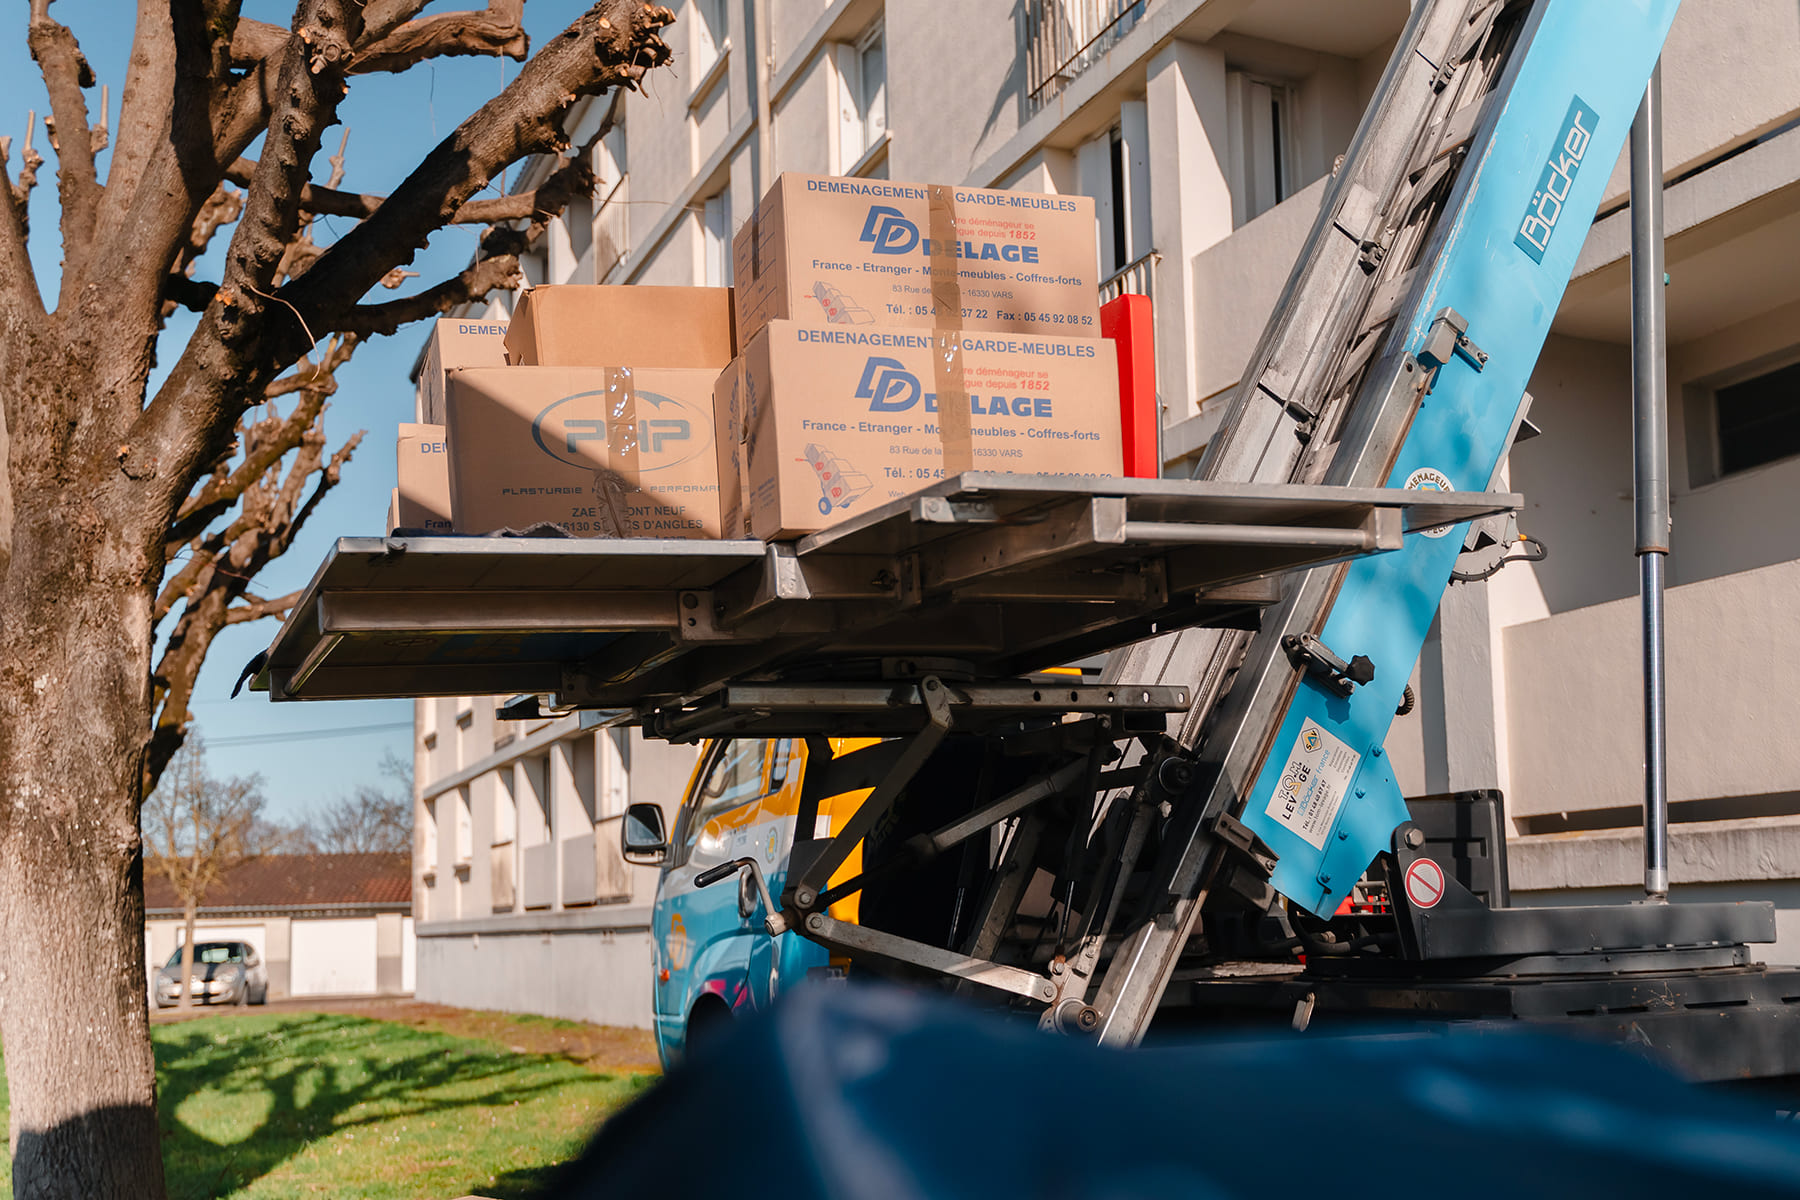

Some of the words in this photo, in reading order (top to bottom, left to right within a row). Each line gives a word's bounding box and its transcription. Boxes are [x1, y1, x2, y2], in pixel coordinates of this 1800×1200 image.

[1519, 110, 1591, 252] Böcker
[807, 180, 935, 200] DEMENAGEMENT
[955, 192, 1077, 212] GARDE-MEUBLES
[968, 217, 1022, 230] déménageur
[978, 229, 1006, 239] depuis
[1009, 230, 1036, 241] 1852
[812, 259, 853, 271] France
[863, 262, 912, 276] Etranger
[1016, 272, 1082, 286] Coffres-forts
[904, 285, 920, 294] Rue
[967, 290, 990, 298] 16330
[992, 290, 1013, 299] VARS
[886, 303, 905, 314] Tél.
[915, 305, 928, 316] 05
[976, 308, 988, 319] 22
[997, 310, 1014, 321] Fax
[1024, 311, 1036, 322] 05
[1038, 312, 1050, 323] 45
[1053, 314, 1065, 324] 92
[1067, 314, 1079, 325] 08
[1081, 315, 1093, 326] 52
[459, 324, 507, 335] DEMEN
[798, 329, 939, 349] DEMENAGEMENT
[962, 338, 1095, 358] GARDE-MEUBLES
[976, 367, 1034, 380] déménageur
[986, 379, 1017, 390] depuis
[1020, 380, 1050, 391] 1852
[924, 393, 1053, 418] DLAGE
[803, 420, 847, 432] France
[859, 422, 913, 435] Etranger
[1027, 428, 1100, 440] Coffres-forts
[902, 446, 920, 455] Rue
[922, 447, 932, 455] de
[934, 447, 942, 455] la
[972, 448, 997, 457] 16330
[999, 449, 1023, 458] VARS
[884, 467, 905, 478] Tél.
[916, 468, 930, 479] 05
[503, 487, 582, 495] PLASTURGIE
[572, 507, 597, 518] ZAE
[626, 506, 651, 517] ONT
[654, 506, 686, 516] NEUF
[425, 519, 452, 529] Fran
[644, 519, 704, 530] D'ANGLES
